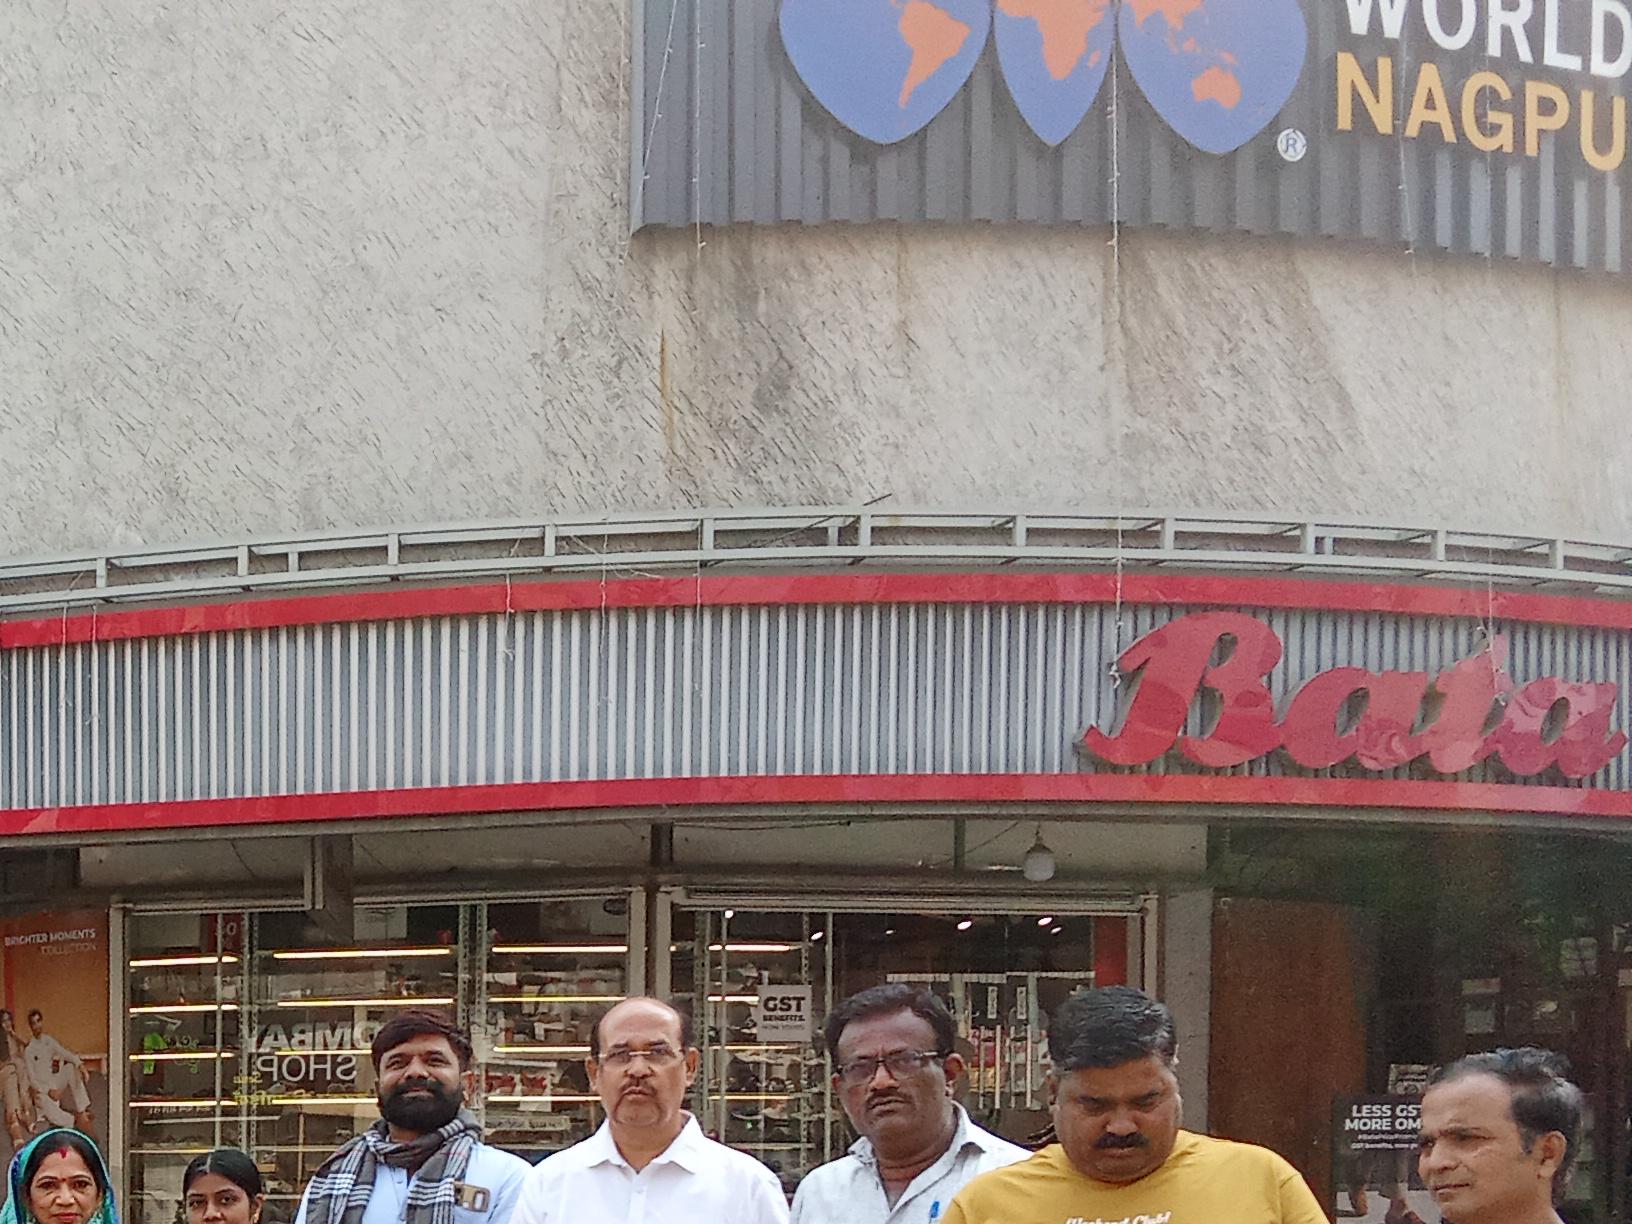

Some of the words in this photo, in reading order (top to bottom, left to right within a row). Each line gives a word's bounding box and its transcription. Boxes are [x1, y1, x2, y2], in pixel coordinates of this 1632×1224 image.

[1079, 610, 1629, 779] Bata
[763, 996, 806, 1012] GST
[1352, 1104, 1392, 1117] LESS
[1344, 1118, 1392, 1131] MORE
[1395, 1118, 1422, 1131] OM
